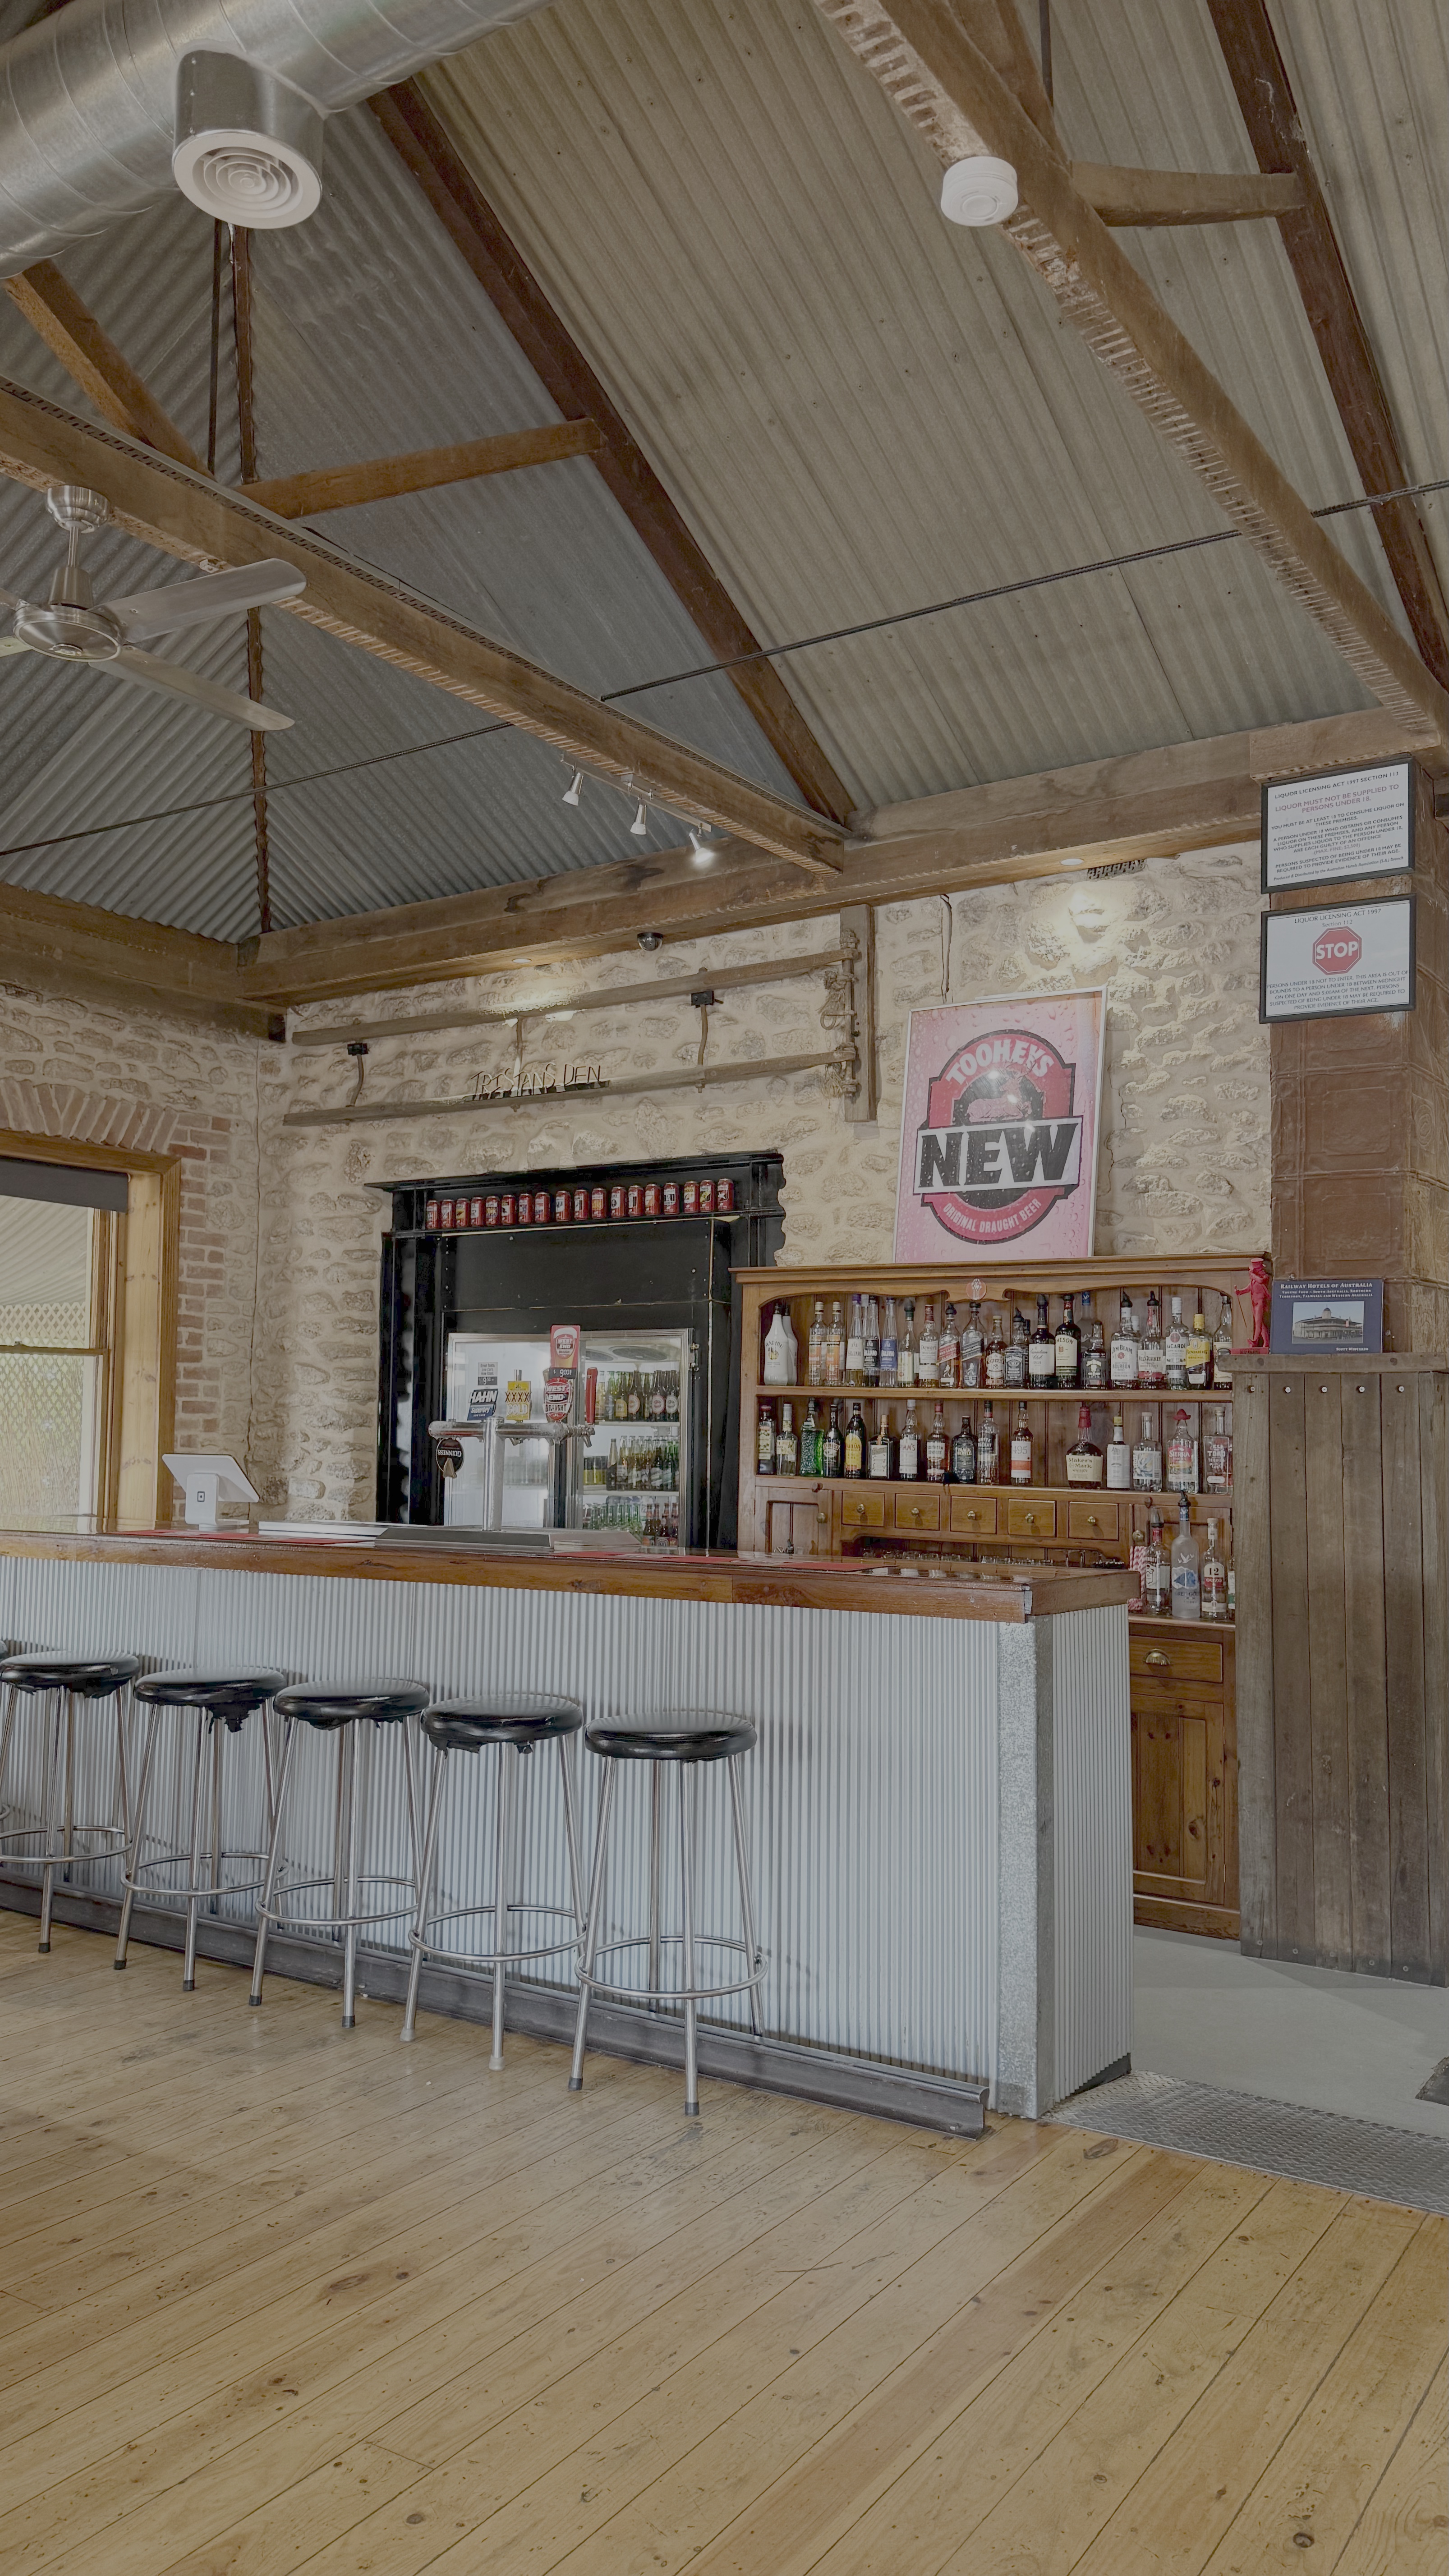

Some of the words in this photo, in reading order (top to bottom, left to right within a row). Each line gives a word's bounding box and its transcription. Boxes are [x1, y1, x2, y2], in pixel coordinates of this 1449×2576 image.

[1299, 785, 1330, 794] LICENSING
[1361, 773, 1388, 782] SECTION
[1275, 803, 1302, 811] LIQUOR
[1304, 798, 1323, 806] MUST
[1353, 787, 1387, 797] SUPPLIED
[1302, 803, 1334, 813] PERSONS
[1336, 798, 1360, 807] UNDER
[1346, 808, 1372, 816] CONSUME
[1373, 815, 1403, 823] CONSUMES
[1299, 856, 1329, 864] SUSPECTED
[1320, 912, 1352, 920] LICENSING
[1316, 941, 1358, 960] STOP
[946, 1039, 1054, 1085] TOOHEYS
[918, 1123, 1079, 1188] NEW
[943, 1203, 976, 1232] ORIGINAL
[979, 1216, 1019, 1233] DRAUGHT
[1020, 1198, 1042, 1221] BEER
[1120, 1345, 1132, 1354] BEAM
[468, 1391, 498, 1403] HAHN
[505, 1392, 529, 1402] XXXX
[508, 1404, 527, 1415] GOLD
